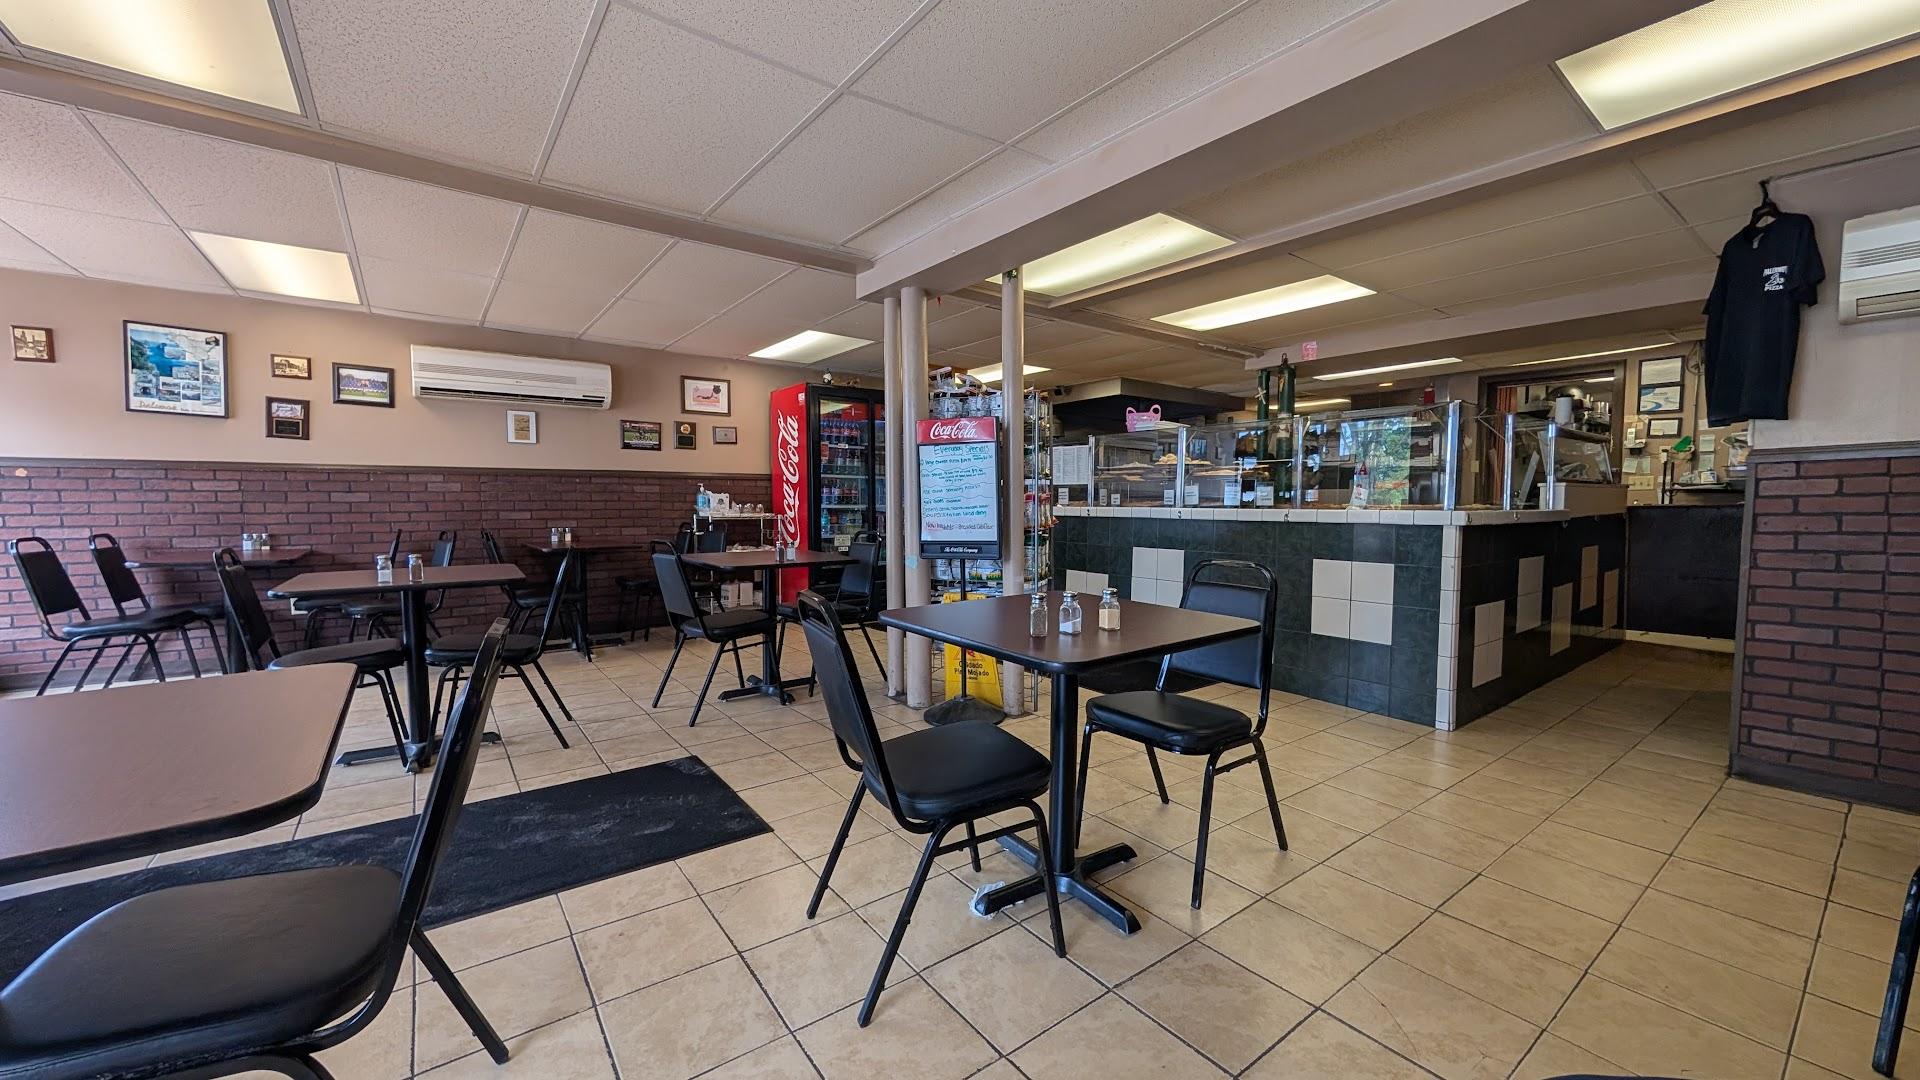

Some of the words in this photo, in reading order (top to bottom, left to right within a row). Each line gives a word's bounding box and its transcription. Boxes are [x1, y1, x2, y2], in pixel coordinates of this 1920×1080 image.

[930, 420, 978, 440] Coca-Cola
[777, 409, 800, 547] Coca-Cola
[959, 661, 983, 669] Cidado
[968, 667, 989, 677] Mojado
